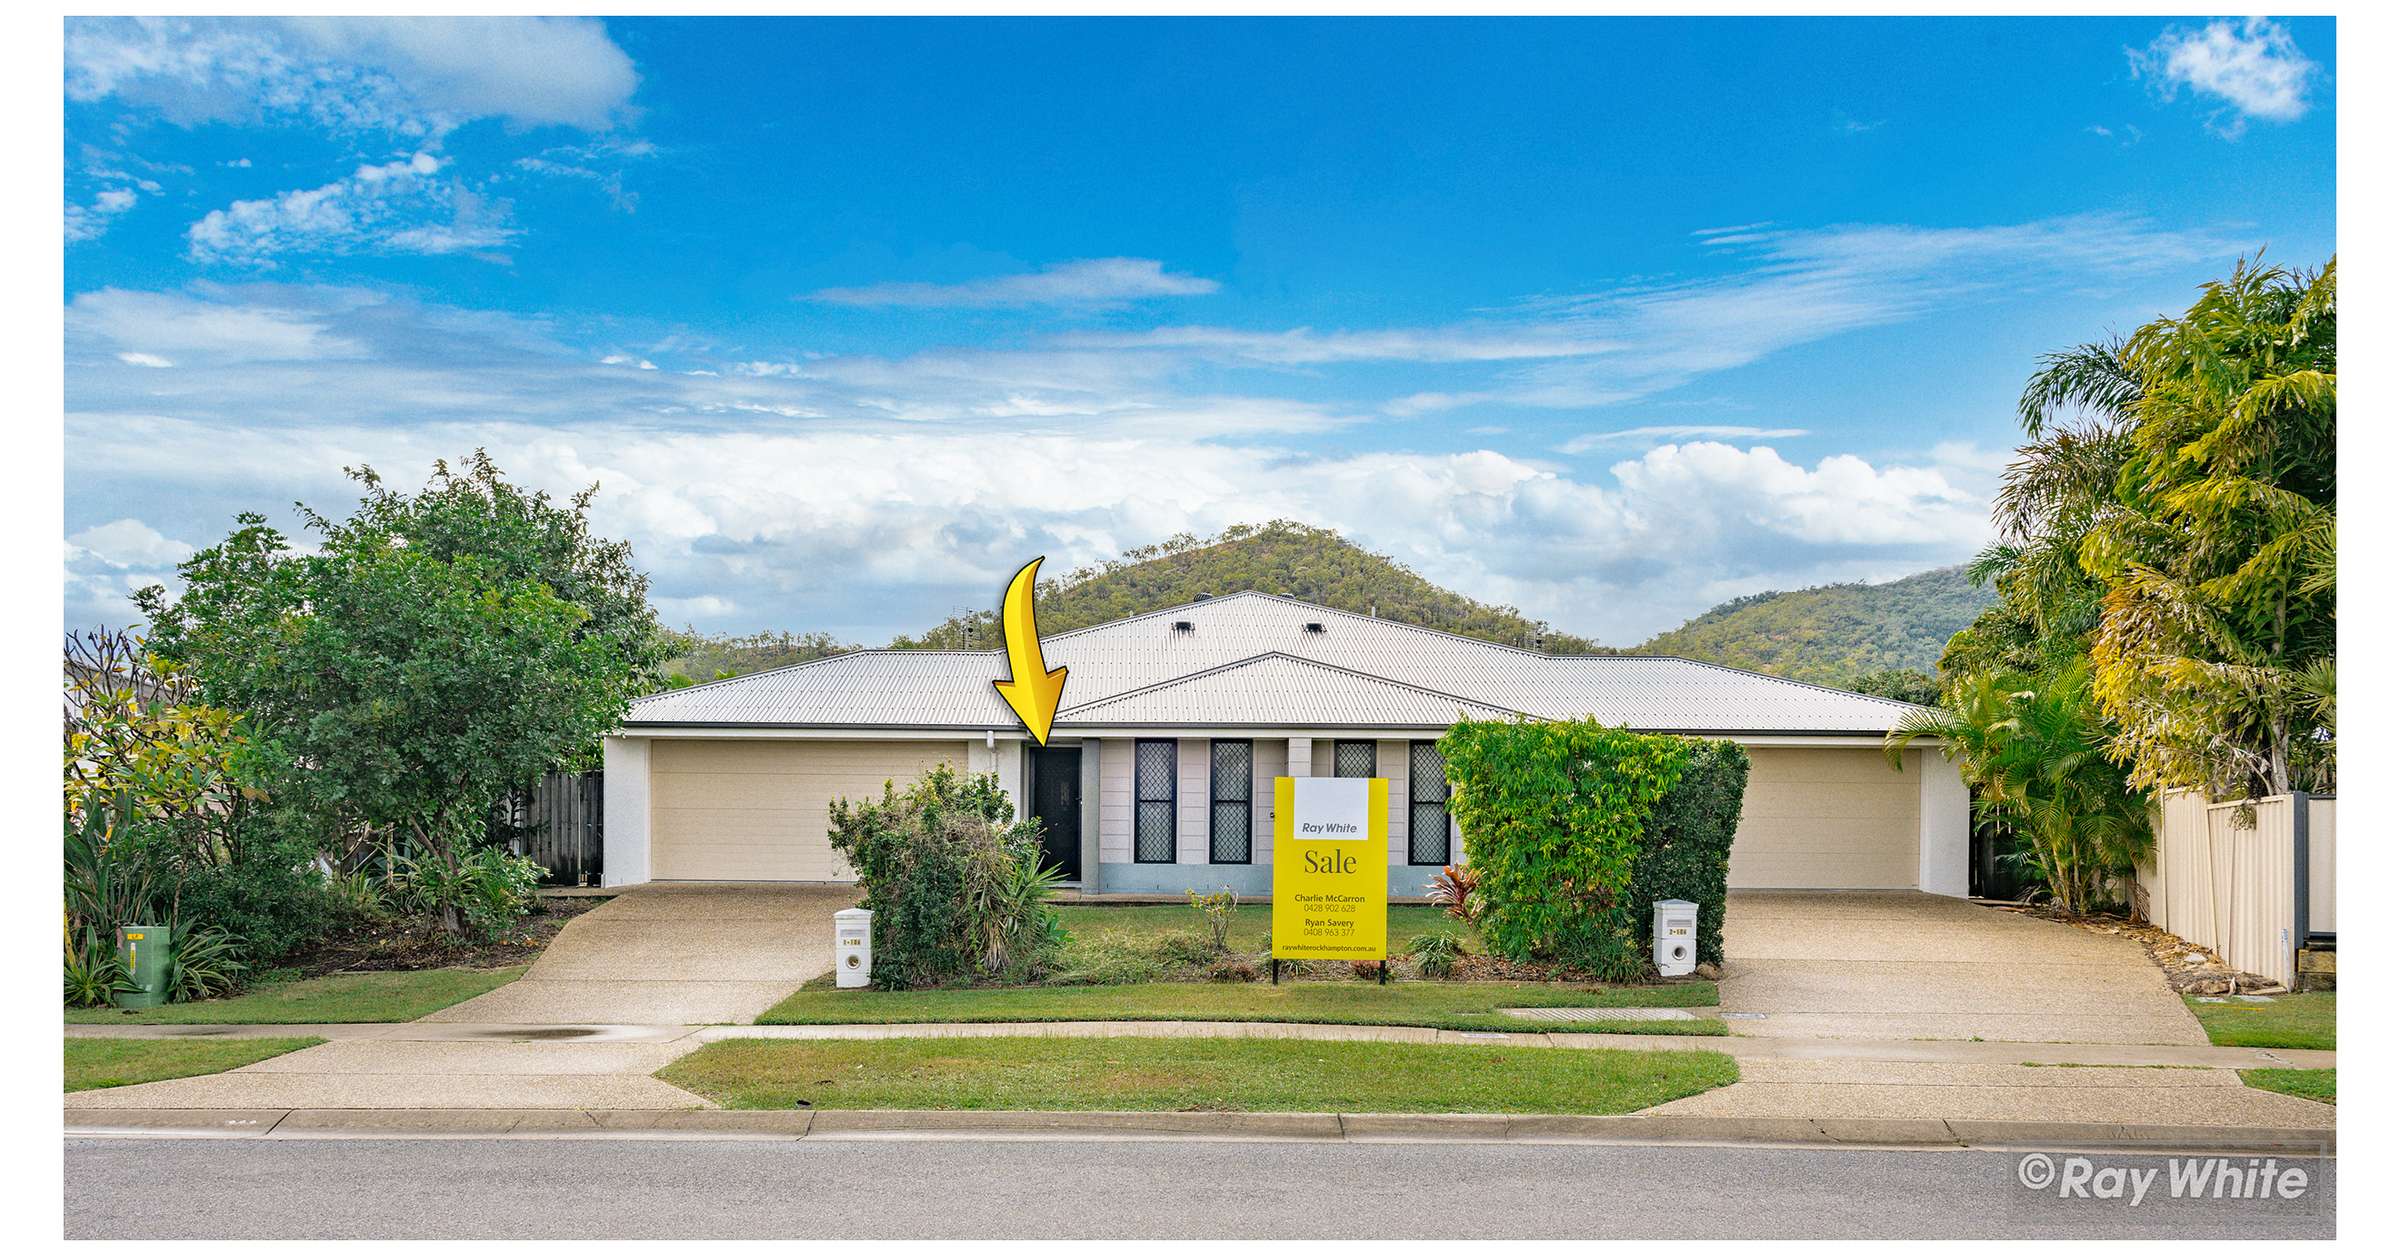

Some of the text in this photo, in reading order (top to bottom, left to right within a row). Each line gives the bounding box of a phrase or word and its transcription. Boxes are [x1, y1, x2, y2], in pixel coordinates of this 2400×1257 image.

[1302, 823, 1358, 834] Ray White
[1304, 848, 1357, 874] Sale
[1294, 894, 1365, 903] Charlie McCarron
[1303, 904, 1356, 913] 0428 902 628
[1305, 918, 1354, 928] Ryan Savery
[1303, 928, 1323, 936] 0408
[1324, 928, 1339, 936] 963
[1282, 944, 1377, 952] raywhiterockhampton.com.au
